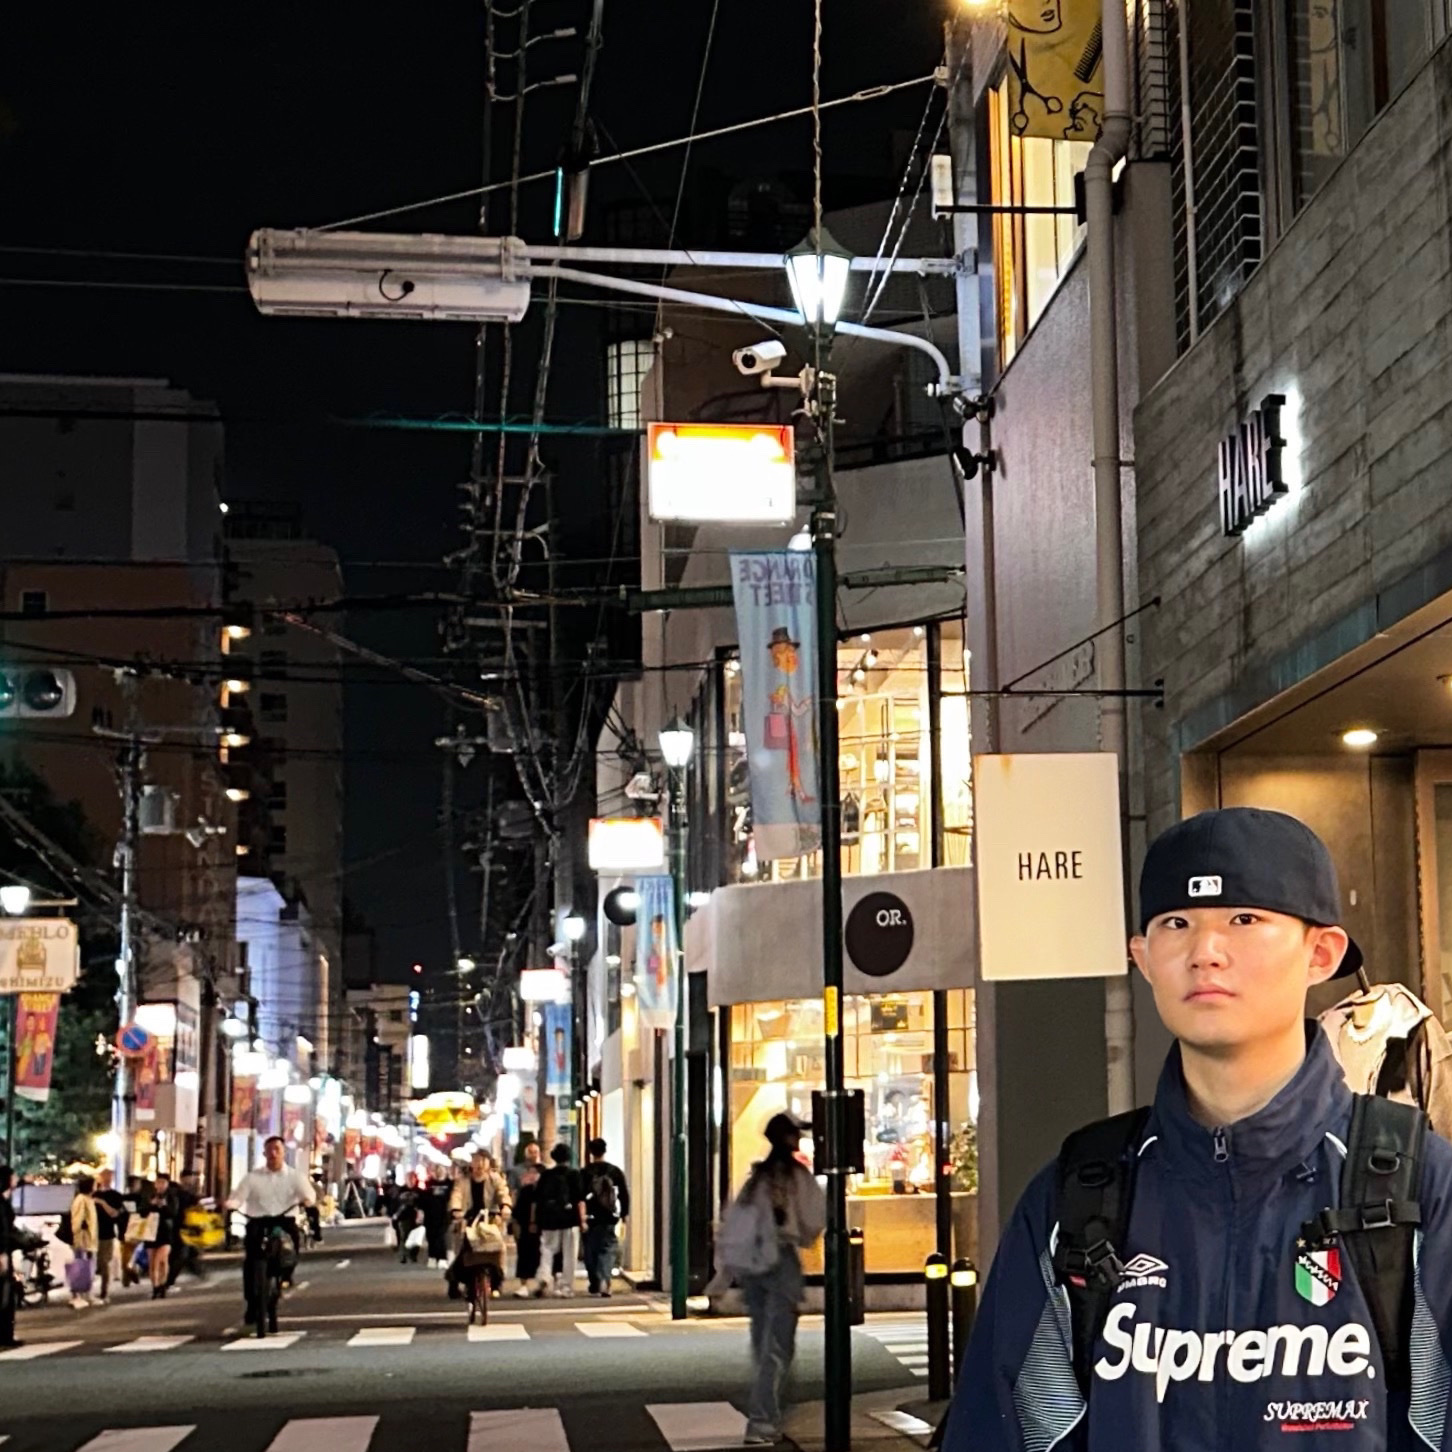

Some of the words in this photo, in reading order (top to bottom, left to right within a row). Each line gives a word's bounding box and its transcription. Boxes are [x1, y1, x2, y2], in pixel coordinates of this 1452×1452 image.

[1218, 395, 1288, 536] HARE
[1018, 851, 1083, 881] HARE
[1263, 1400, 1369, 1422] SUPREMAX
